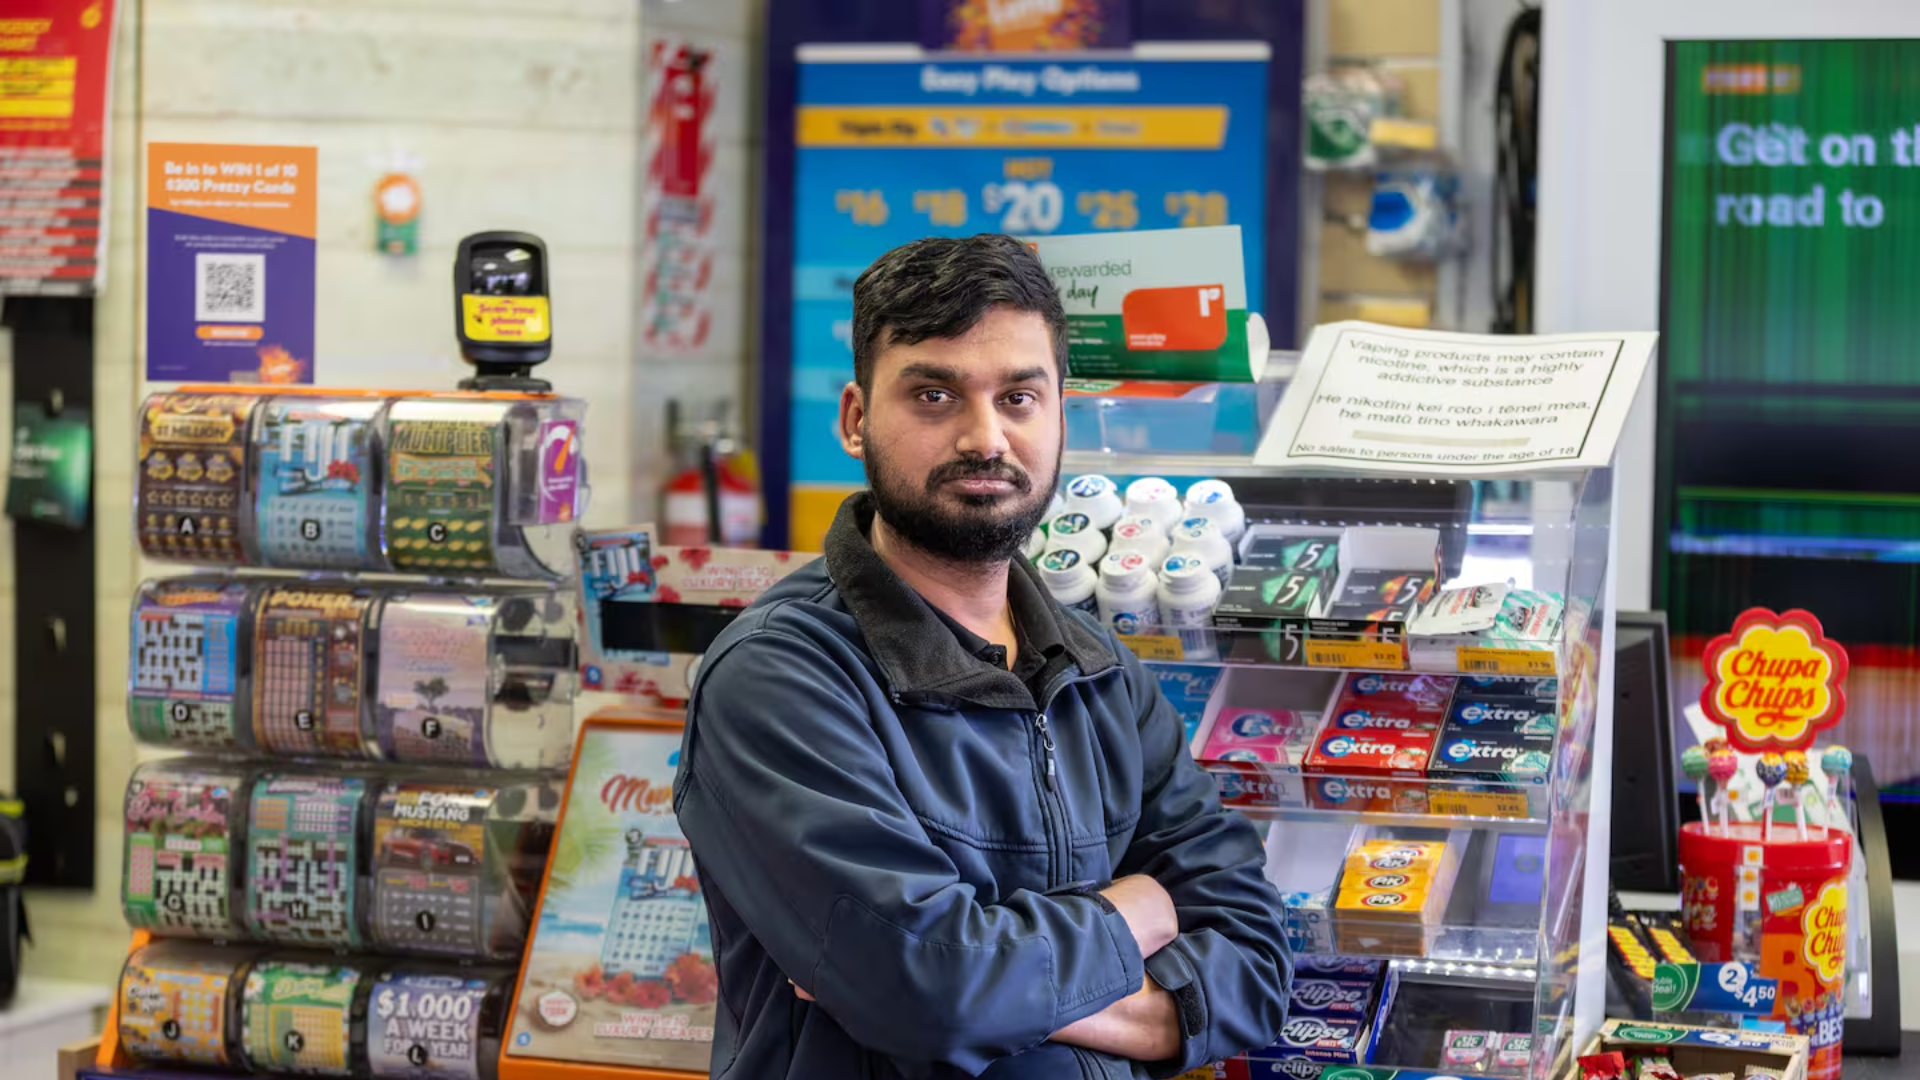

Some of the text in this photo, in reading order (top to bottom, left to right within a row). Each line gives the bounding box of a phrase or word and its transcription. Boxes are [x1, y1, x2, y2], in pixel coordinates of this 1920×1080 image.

[921, 65, 1140, 96] Easy Play Options
[1820, 132, 1876, 168] on
[165, 160, 183, 175] Be
[202, 163, 217, 175] to
[282, 163, 298, 178] 10
[982, 182, 1063, 232] $20
[1716, 183, 1884, 228] road to
[1049, 260, 1132, 278] rewarded
[1066, 279, 1099, 309] day
[1350, 339, 1604, 364] Vaping products may contain
[1438, 363, 1489, 374] which
[1494, 365, 1509, 375] is
[1514, 366, 1525, 374] a
[1531, 361, 1585, 375] highly
[1377, 371, 1554, 388] addictive substance
[1315, 394, 1342, 404] He
[1415, 402, 1442, 413] kei
[1447, 404, 1483, 414] roto
[1338, 408, 1362, 419] he
[1417, 414, 1450, 426] tino
[1456, 415, 1558, 428] whakawara
[173, 425, 226, 438] MILLION
[393, 429, 492, 456] MULTIPLIER
[1295, 444, 1575, 461] No sales to persons under the age of 18
[180, 517, 194, 534] A
[304, 523, 318, 539] B
[430, 525, 444, 542] C
[1299, 544, 1324, 569] 5
[1277, 576, 1305, 604] 5
[1397, 578, 1422, 604] 5
[270, 590, 353, 609] POKER
[1285, 624, 1299, 661] 5
[1157, 670, 1193, 682] tra
[1731, 649, 1822, 687] Chupa
[1725, 679, 1816, 727] Chups
[173, 705, 188, 720] D
[297, 713, 311, 729] E
[1343, 713, 1412, 729] extra
[1462, 706, 1530, 721] extra
[424, 720, 438, 737] F
[1327, 738, 1396, 756] extra
[1448, 743, 1519, 759] extra
[1323, 780, 1392, 801] extra
[393, 803, 470, 822] MUSTANG
[168, 895, 182, 911] G
[289, 902, 303, 918] H
[1724, 968, 1739, 986] 2
[1291, 984, 1363, 1005] clipse
[622, 1012, 653, 1026] WIN
[167, 1022, 178, 1038] J
[385, 1017, 470, 1042] A WEEK
[595, 1023, 714, 1041] LUXURY ESCAPES
[1281, 1022, 1350, 1042] clipse
[287, 1034, 300, 1048] K
[411, 1046, 423, 1064] L
[430, 1042, 470, 1060] YEAR
